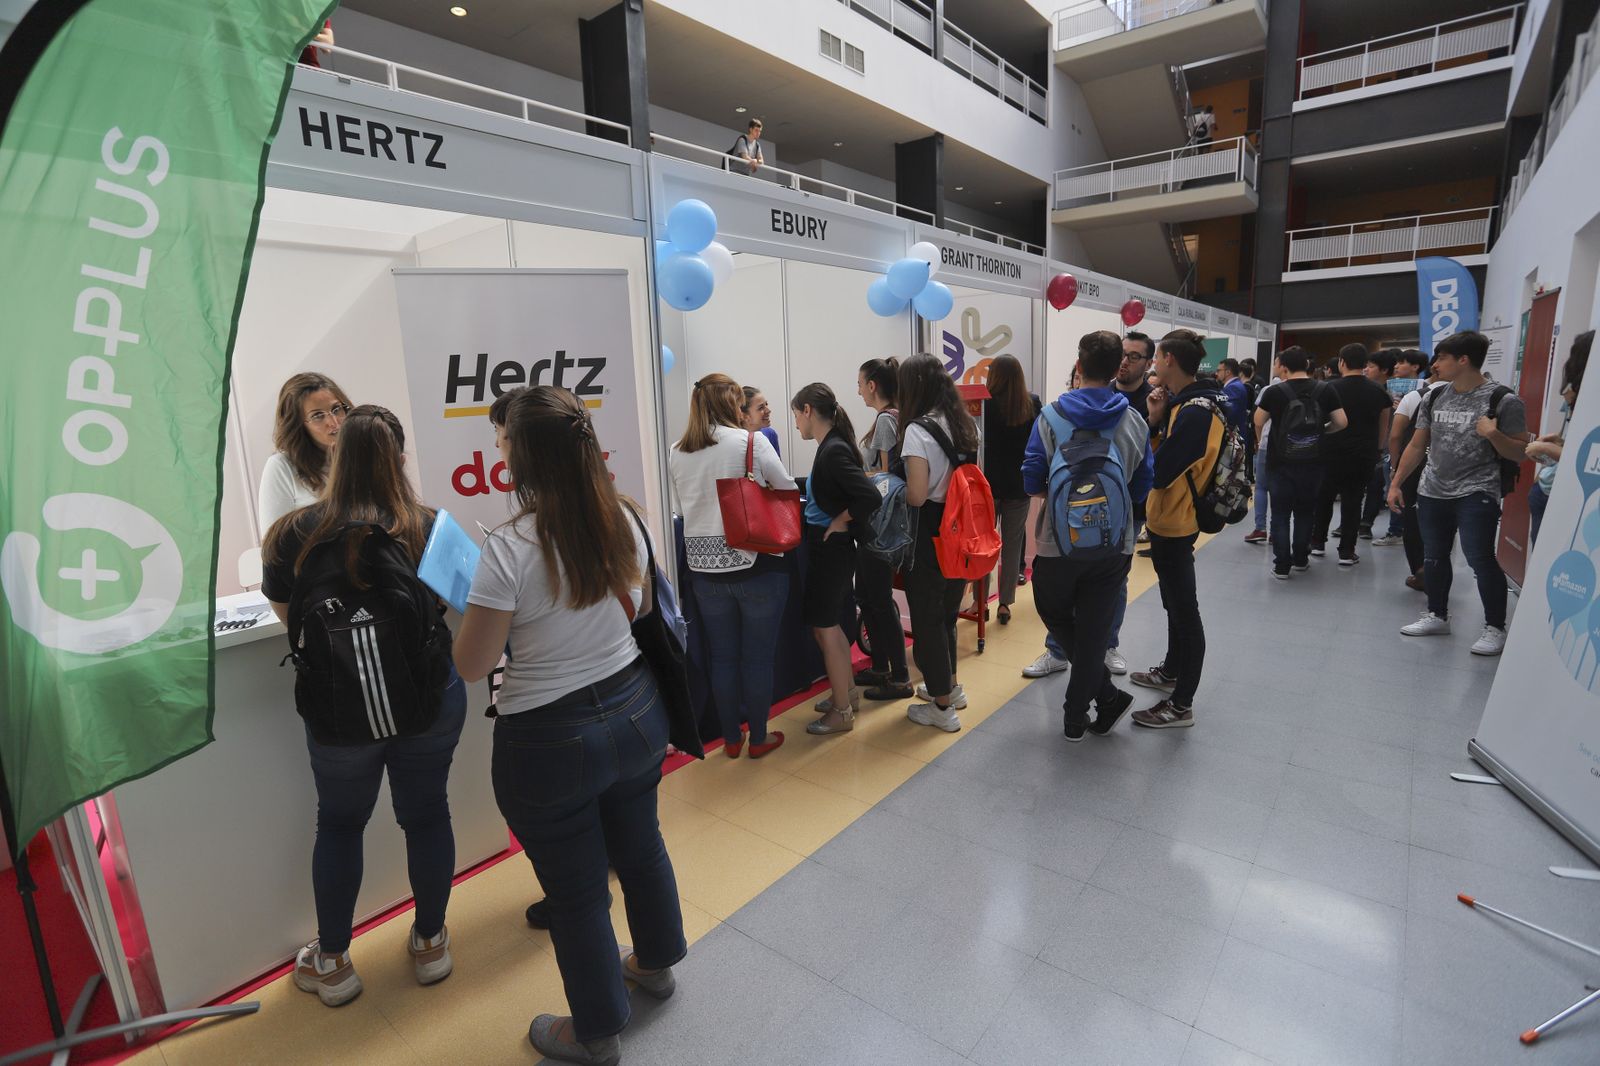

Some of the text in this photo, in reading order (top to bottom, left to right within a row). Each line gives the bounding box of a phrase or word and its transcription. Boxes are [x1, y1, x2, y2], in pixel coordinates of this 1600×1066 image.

[298, 106, 447, 170] HERTZ
[770, 208, 828, 241] EBURY
[941, 246, 1022, 280] GRANT THORNTON
[1089, 283, 1100, 298] BPO
[445, 350, 607, 404] Hertz
[1433, 410, 1475, 424] TRUST
[350, 614, 374, 623] adidas
